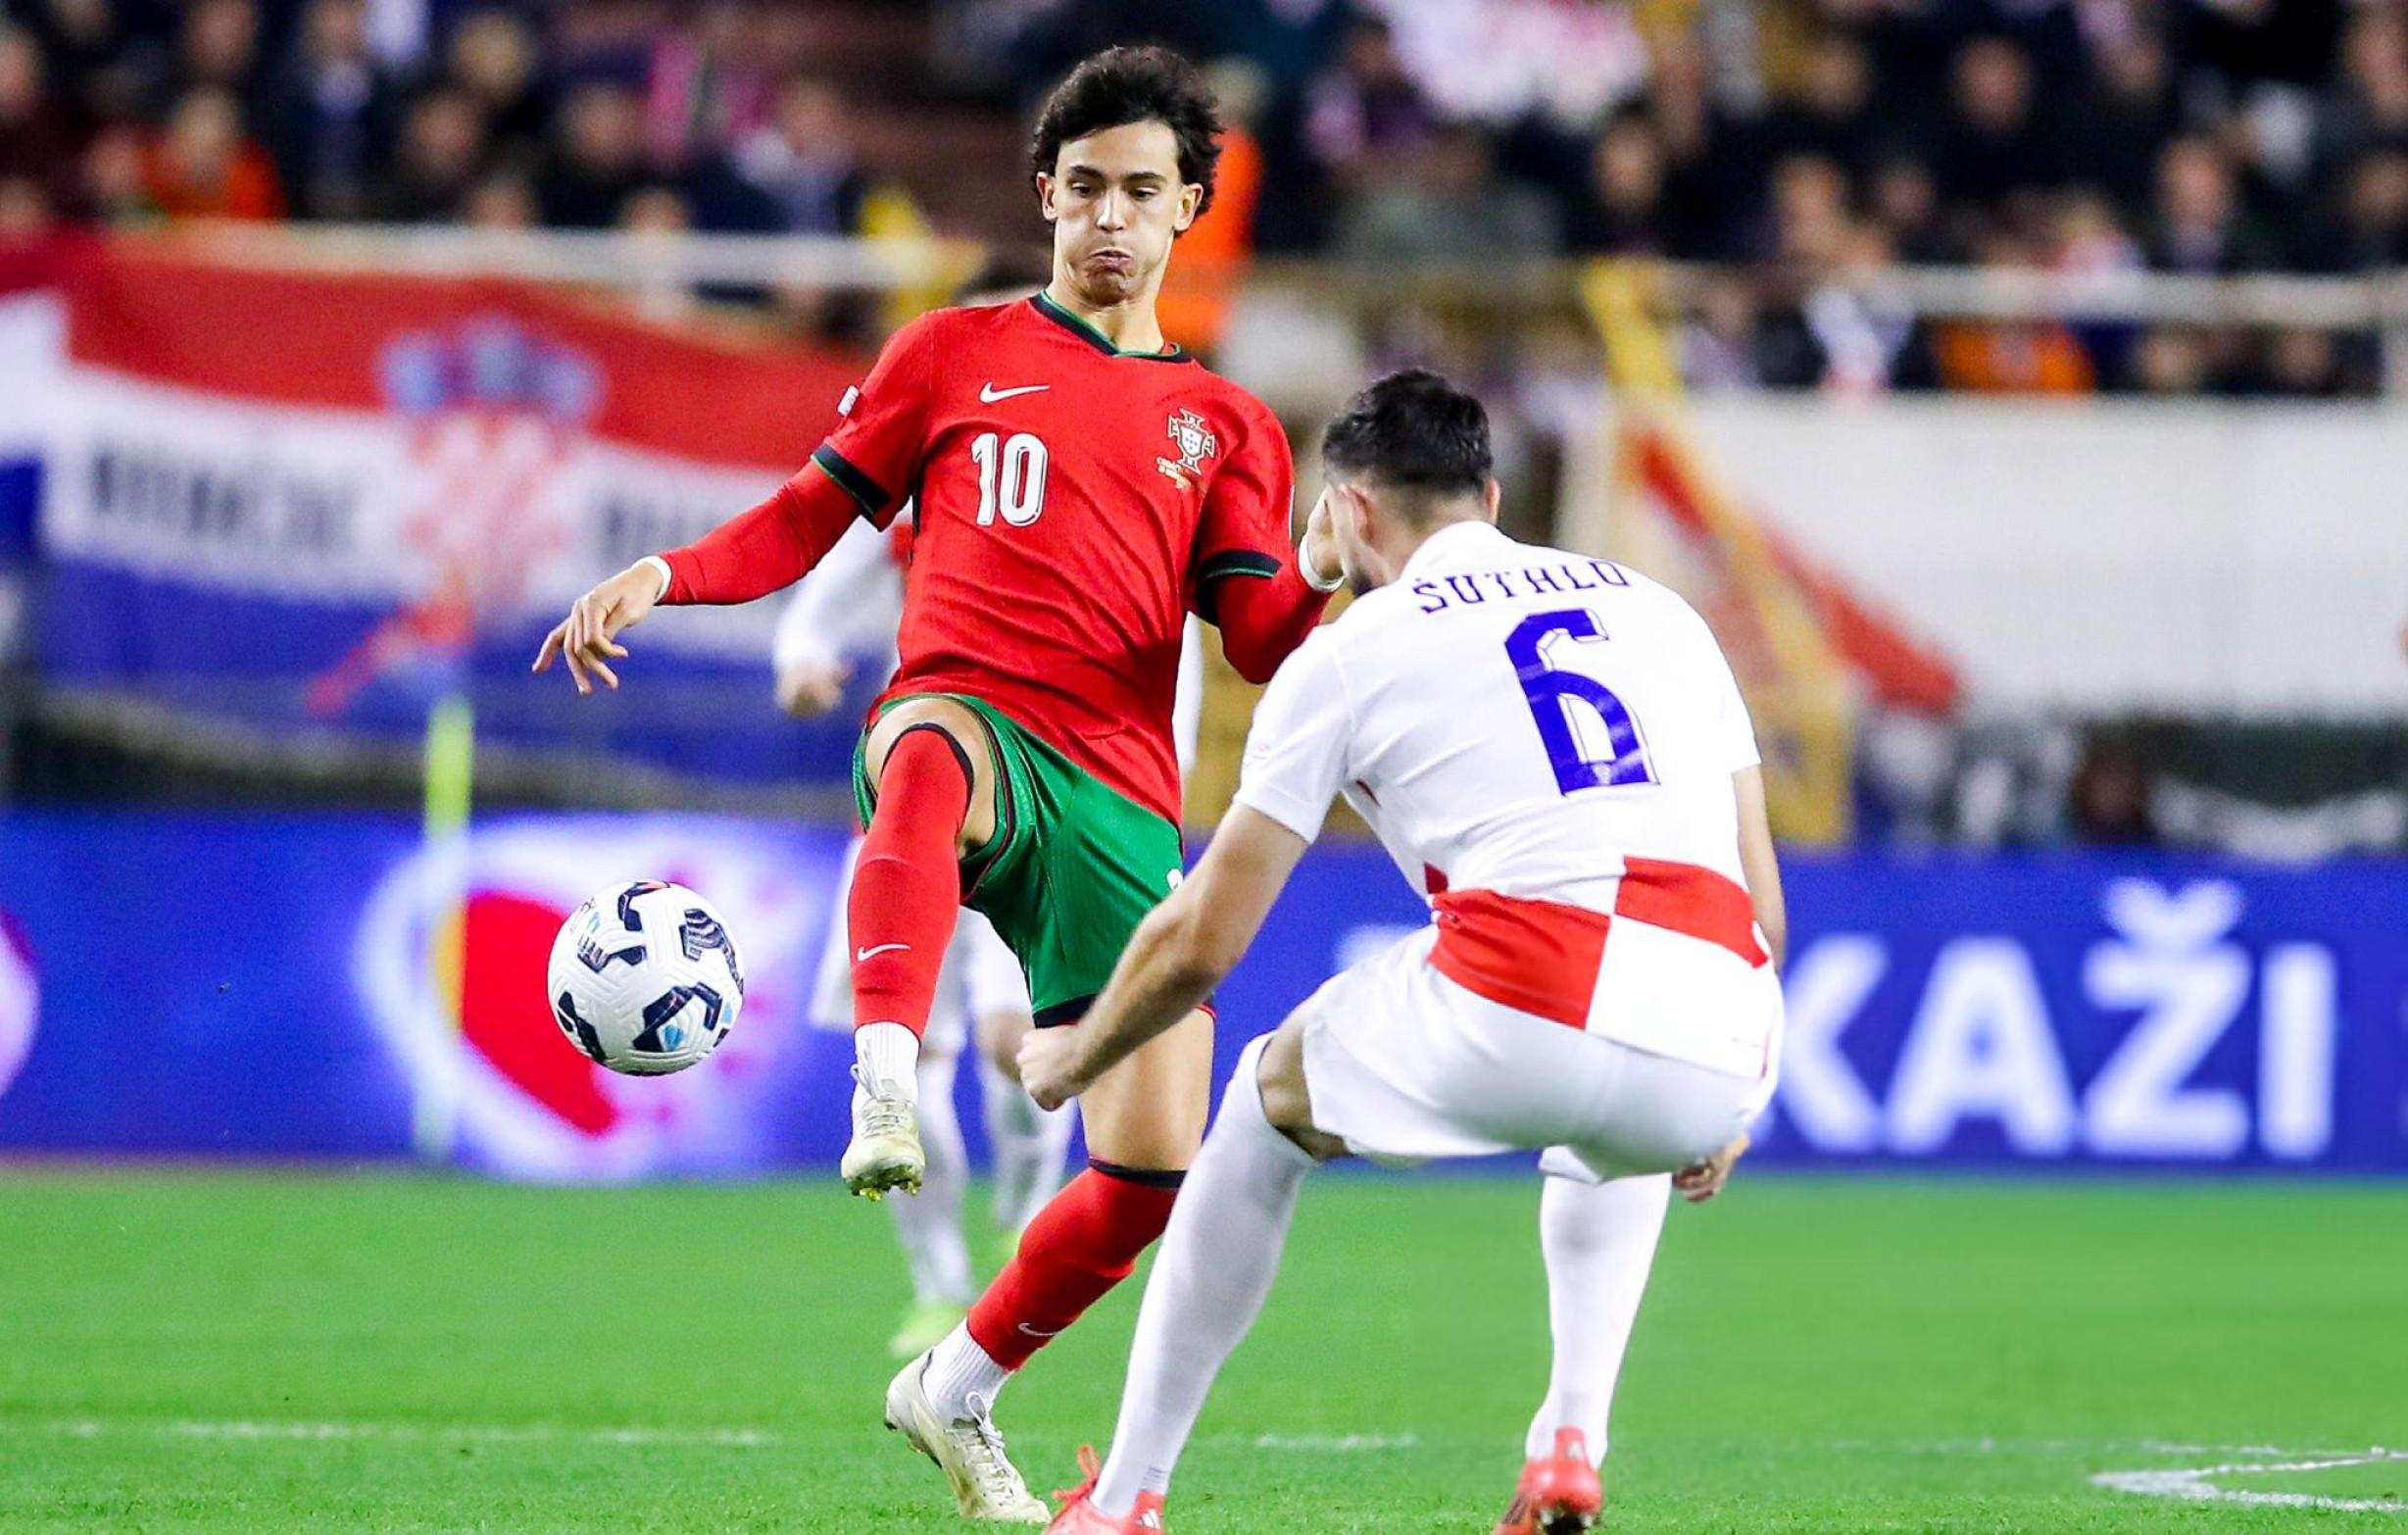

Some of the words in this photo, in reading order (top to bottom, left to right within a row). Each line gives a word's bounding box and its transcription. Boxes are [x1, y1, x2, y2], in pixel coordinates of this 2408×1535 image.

[971, 432, 1049, 526] 10
[1504, 608, 1660, 796] 6
[1749, 875, 2338, 1160] KAŽI
